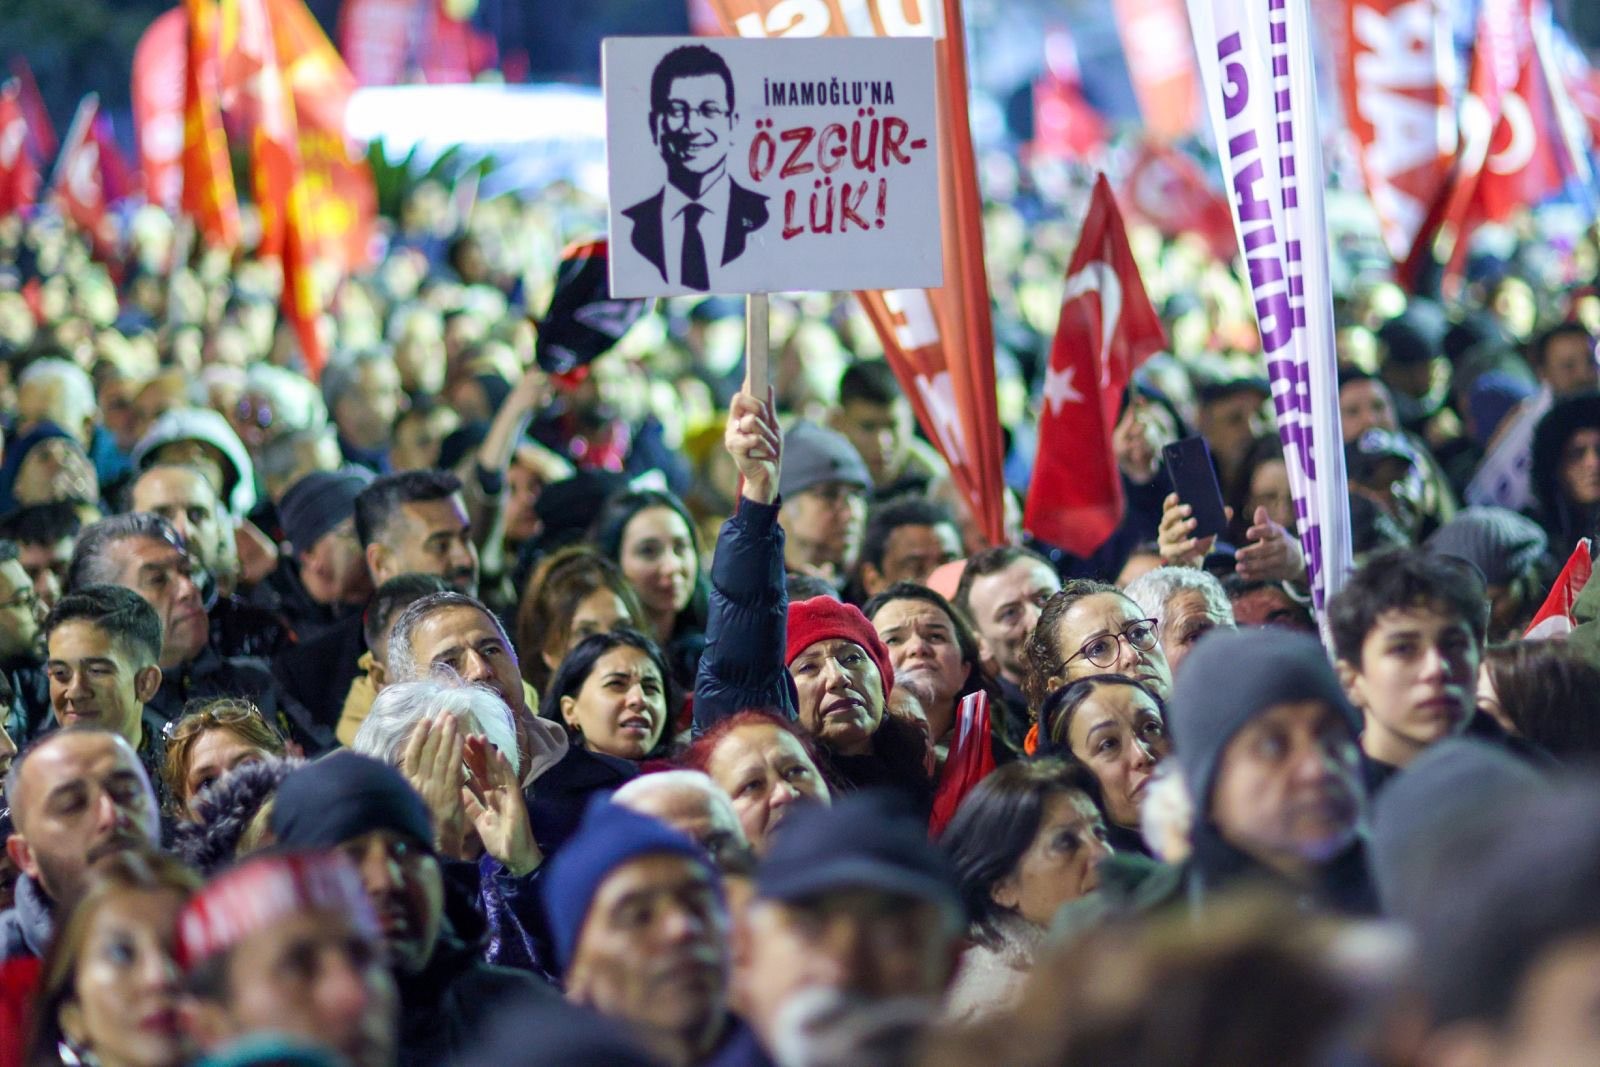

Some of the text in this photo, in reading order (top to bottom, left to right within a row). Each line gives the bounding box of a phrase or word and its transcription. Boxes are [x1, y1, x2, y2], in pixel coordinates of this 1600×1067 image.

[764, 77, 895, 106] İMAMOĞLU'NA
[748, 106, 928, 182] ÖZGÜR-
[782, 176, 888, 240] LÜK!
